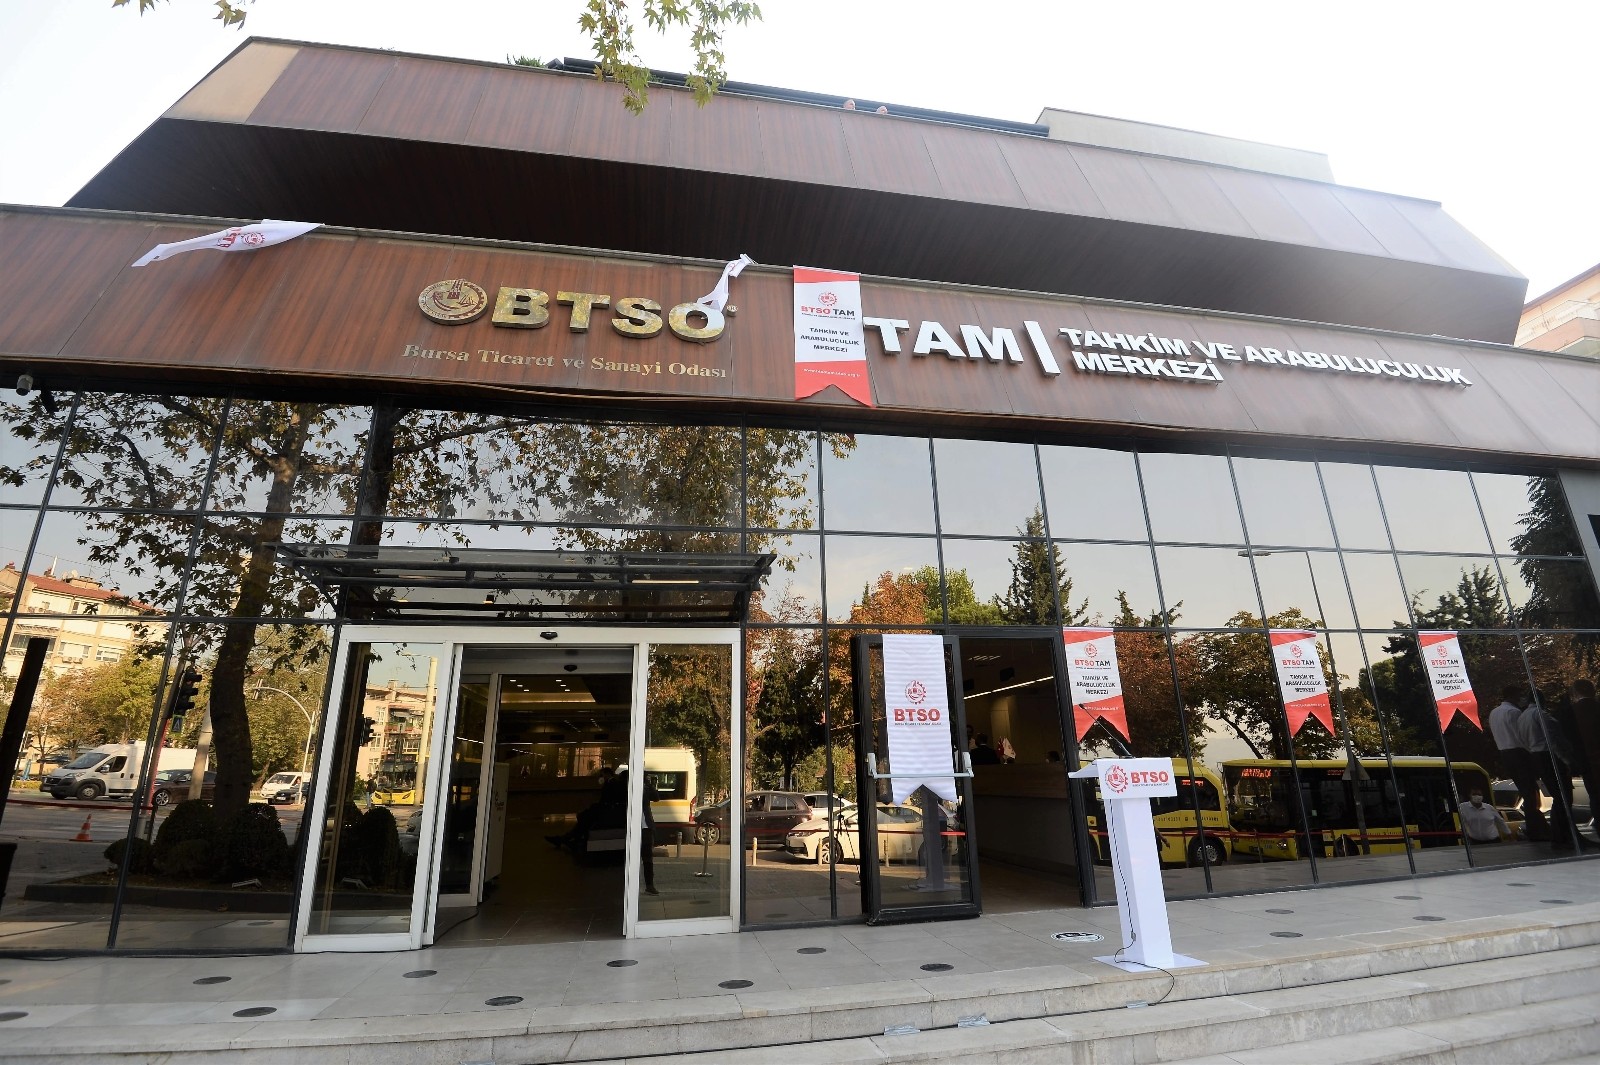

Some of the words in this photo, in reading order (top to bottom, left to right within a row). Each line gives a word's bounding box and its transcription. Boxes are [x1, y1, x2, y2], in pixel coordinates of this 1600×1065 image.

[492, 286, 725, 344] BTSO
[801, 306, 831, 314] BTSO
[863, 316, 1024, 363] TAM
[402, 344, 470, 362] Bursa
[477, 349, 555, 367] Ticaret
[562, 358, 585, 369] ve
[590, 357, 662, 376] Sanayi
[668, 362, 727, 378] Odası
[1058, 327, 1192, 357] TAHKİM
[1191, 341, 1242, 361] VE
[1243, 345, 1473, 387] ARABULUCULUK
[1071, 351, 1224, 382] MERKEZİ
[1074, 659, 1095, 667] BTSO
[893, 708, 941, 722] BTSO
[1130, 770, 1169, 784] BTSO
